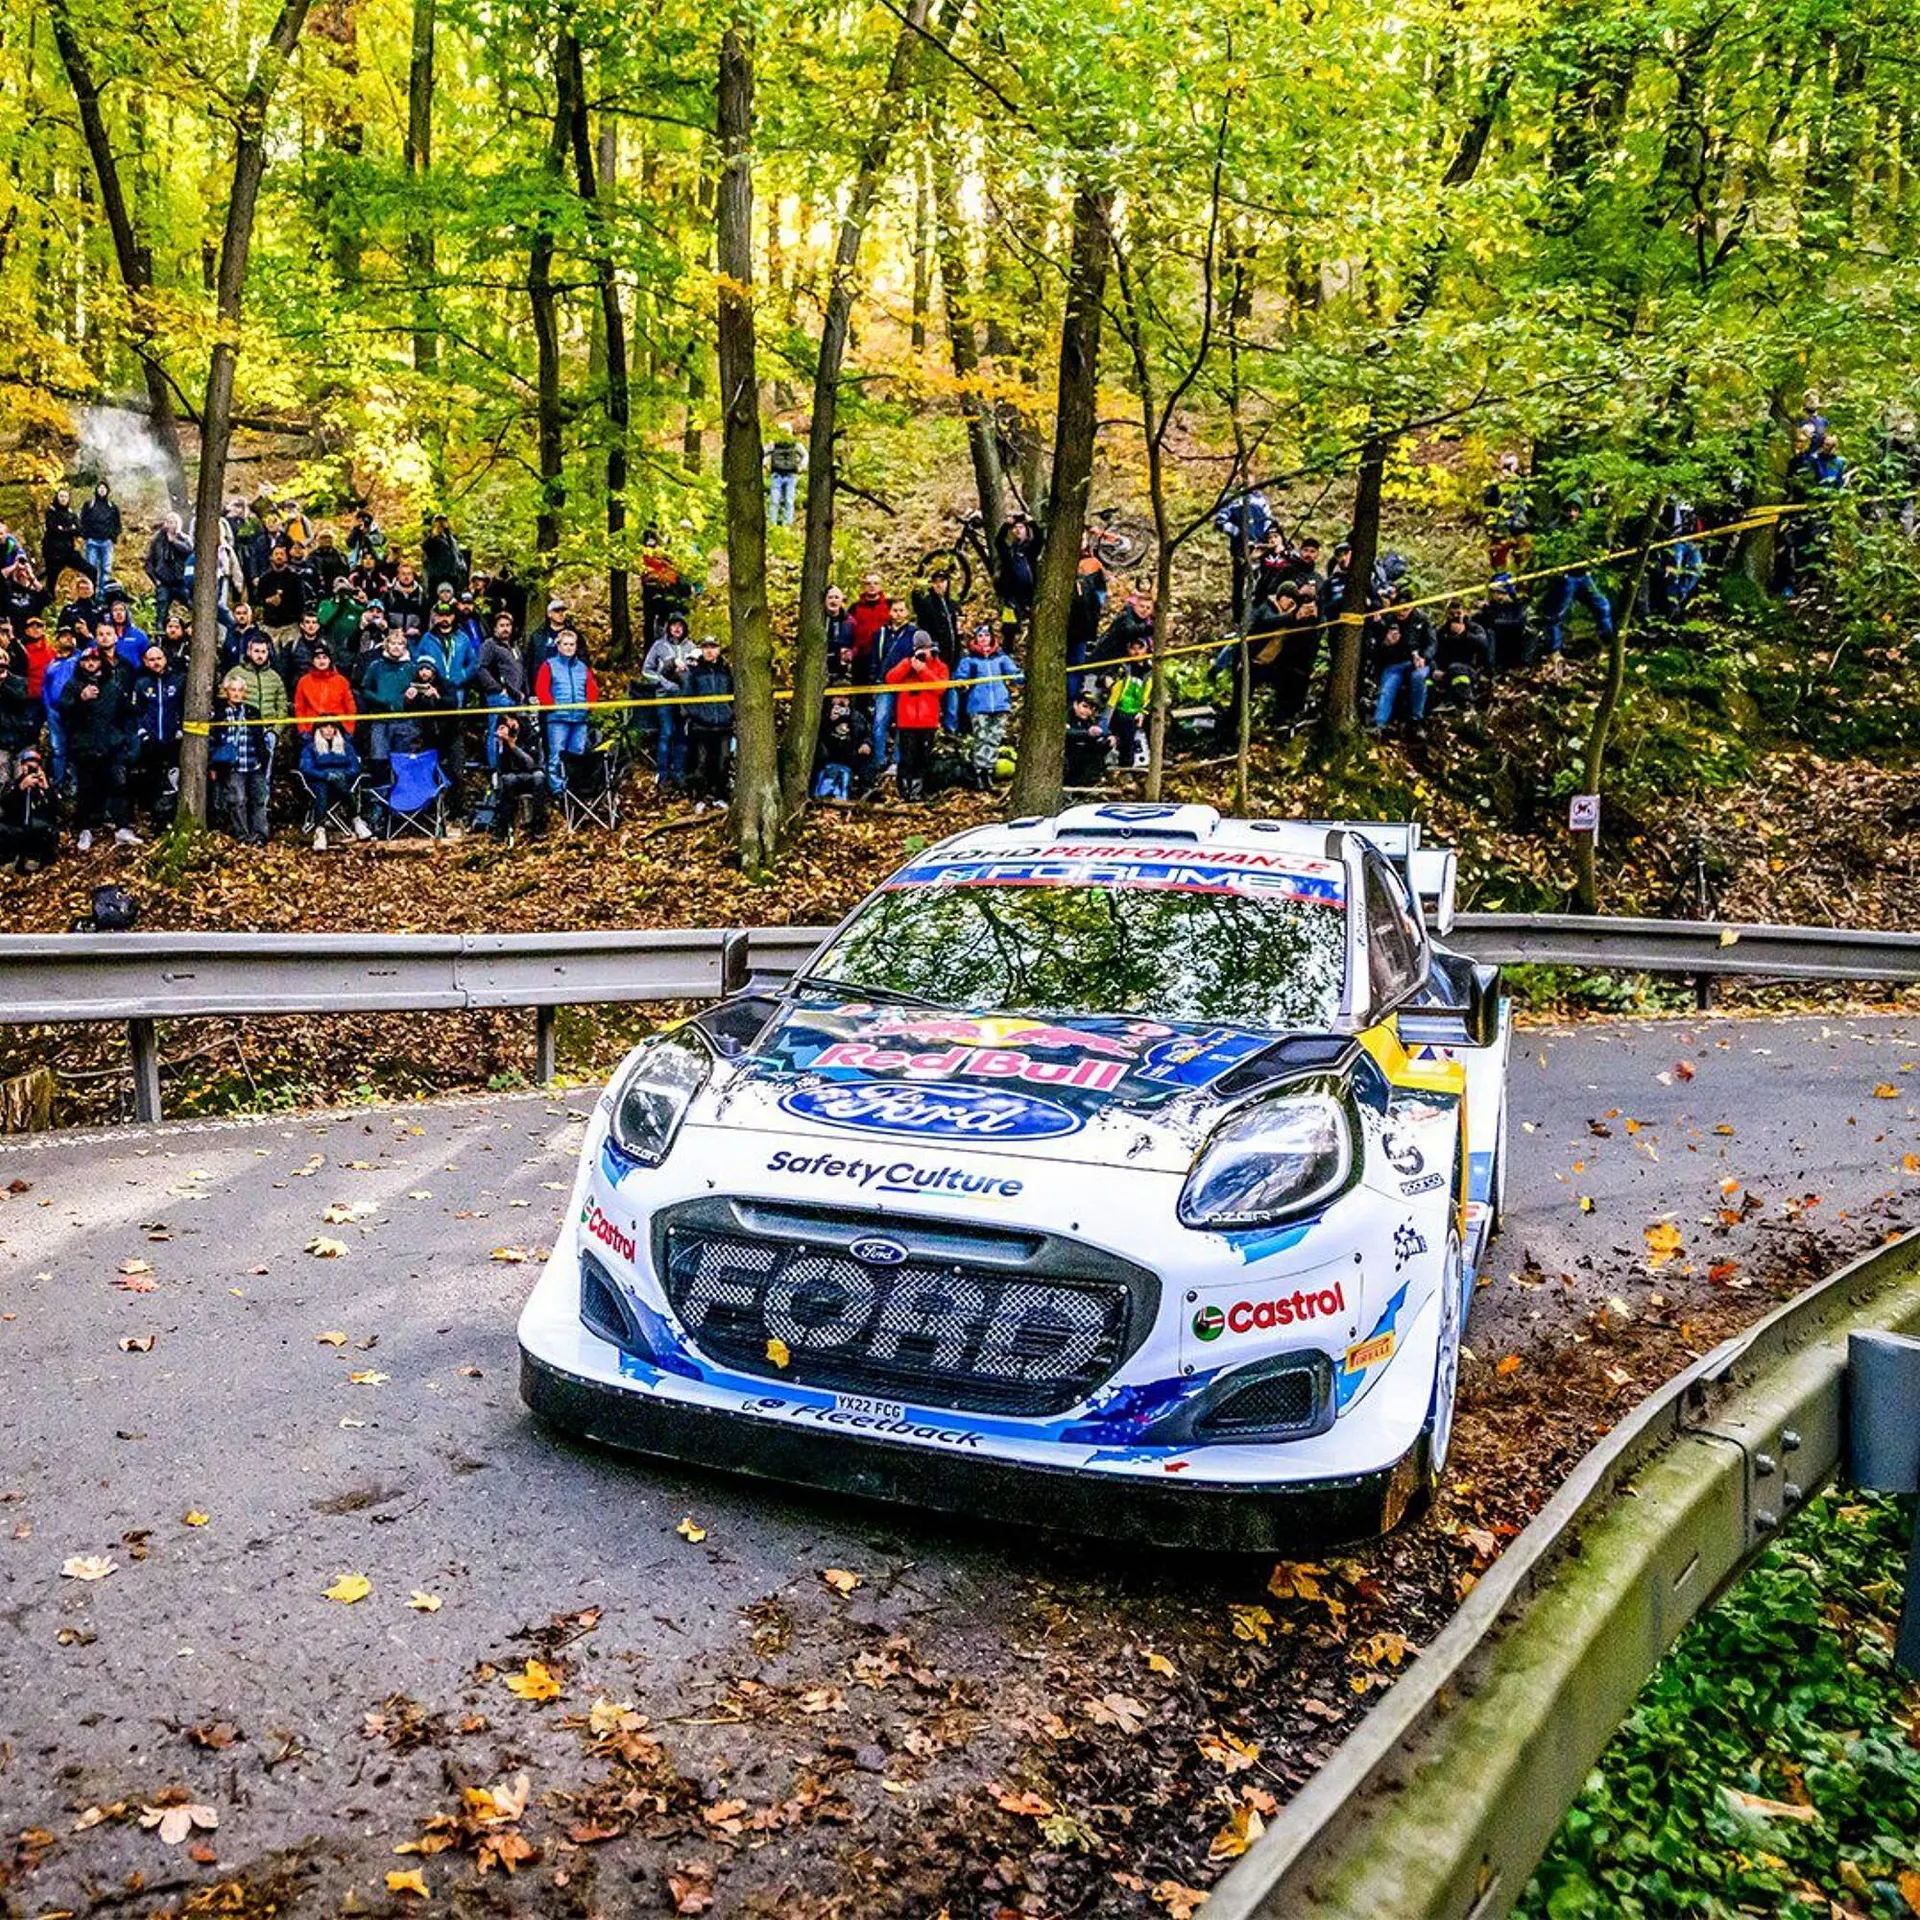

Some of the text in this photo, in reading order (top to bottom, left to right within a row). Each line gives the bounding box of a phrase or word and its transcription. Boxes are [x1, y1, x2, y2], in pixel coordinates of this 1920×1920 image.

[813, 1043, 1130, 1091] Red Bull
[812, 1082, 1029, 1132] Ford
[767, 1150, 1023, 1196] SafetyCulture
[588, 1207, 635, 1264] Castrol
[861, 1243, 895, 1260] Ford
[683, 1242, 1105, 1380] FORD
[1228, 1281, 1345, 1333] Castrol
[790, 1403, 985, 1448] Fleetback
[875, 1402, 901, 1418] FCG
